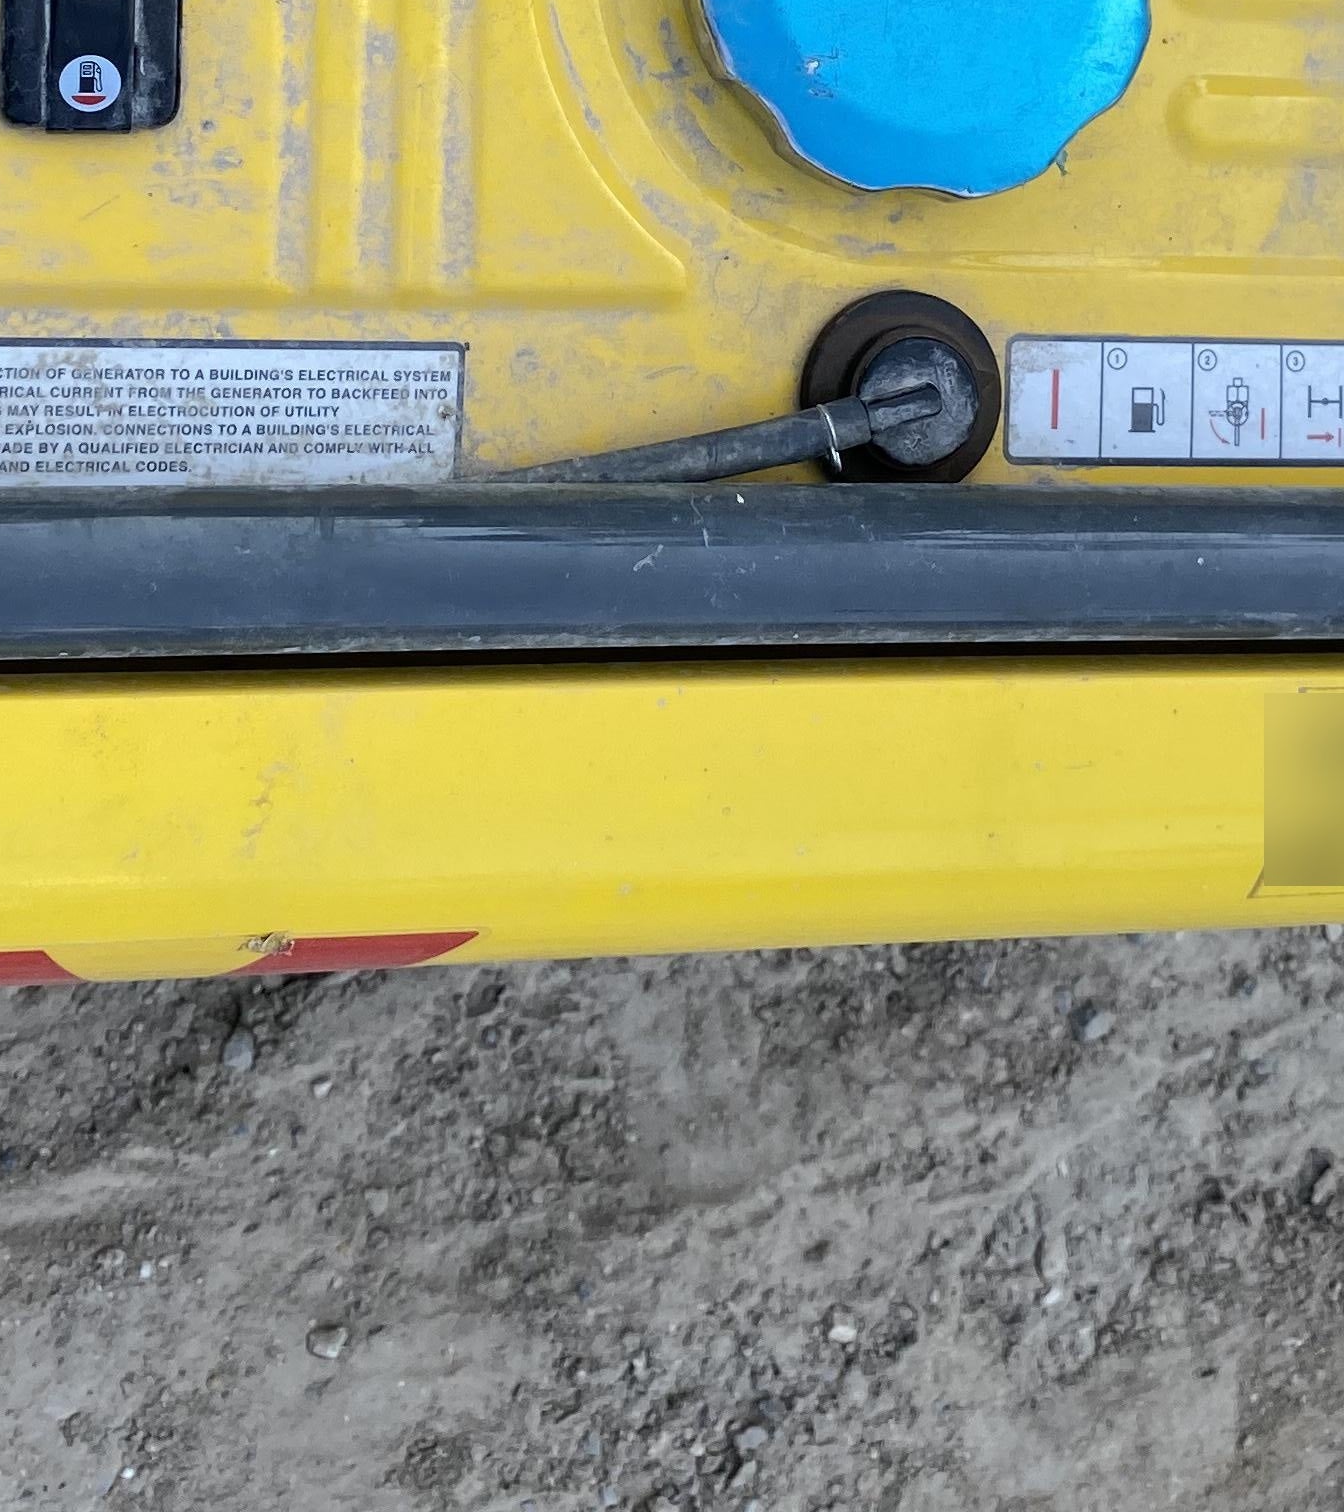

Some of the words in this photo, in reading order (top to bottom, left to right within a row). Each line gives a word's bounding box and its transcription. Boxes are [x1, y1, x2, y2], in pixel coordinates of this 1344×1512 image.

[44, 367, 65, 380] OF
[70, 368, 165, 381] GENERATOR
[169, 368, 190, 381] TO
[193, 368, 204, 381] A
[208, 369, 293, 382] BUILDING'S
[297, 369, 389, 382] ELECTRICAL
[392, 370, 451, 383] SYSTEM
[48, 386, 122, 399] CURRENT
[127, 387, 172, 399] FROM
[176, 387, 205, 399] THE
[209, 387, 302, 400] GENERATOR
[306, 387, 326, 400] TO
[330, 388, 409, 400] BACKFEED
[413, 388, 448, 400] INTO
[6, 405, 39, 417] MAY
[127, 405, 255, 418] ELECTROCUTION
[258, 406, 279, 418] OF
[283, 406, 340, 418] UTILITY
[2, 424, 96, 436] EXPLOSION.
[100, 424, 213, 436] CONNECTIONS
[216, 424, 238, 436] TO
[240, 424, 252, 436] A
[254, 424, 340, 436] BUILDING'S
[344, 424, 435, 437] ELECTRICAL
[37, 442, 58, 455] BY
[62, 442, 73, 455] A
[77, 442, 159, 455] QUALIFIED
[163, 442, 263, 455] ELECTRICIAN
[266, 443, 299, 455] AND
[367, 443, 405, 455] WITH
[407, 443, 435, 455] ALL
[34, 461, 130, 473] ELECTRICAL
[134, 461, 192, 473] CODES.
